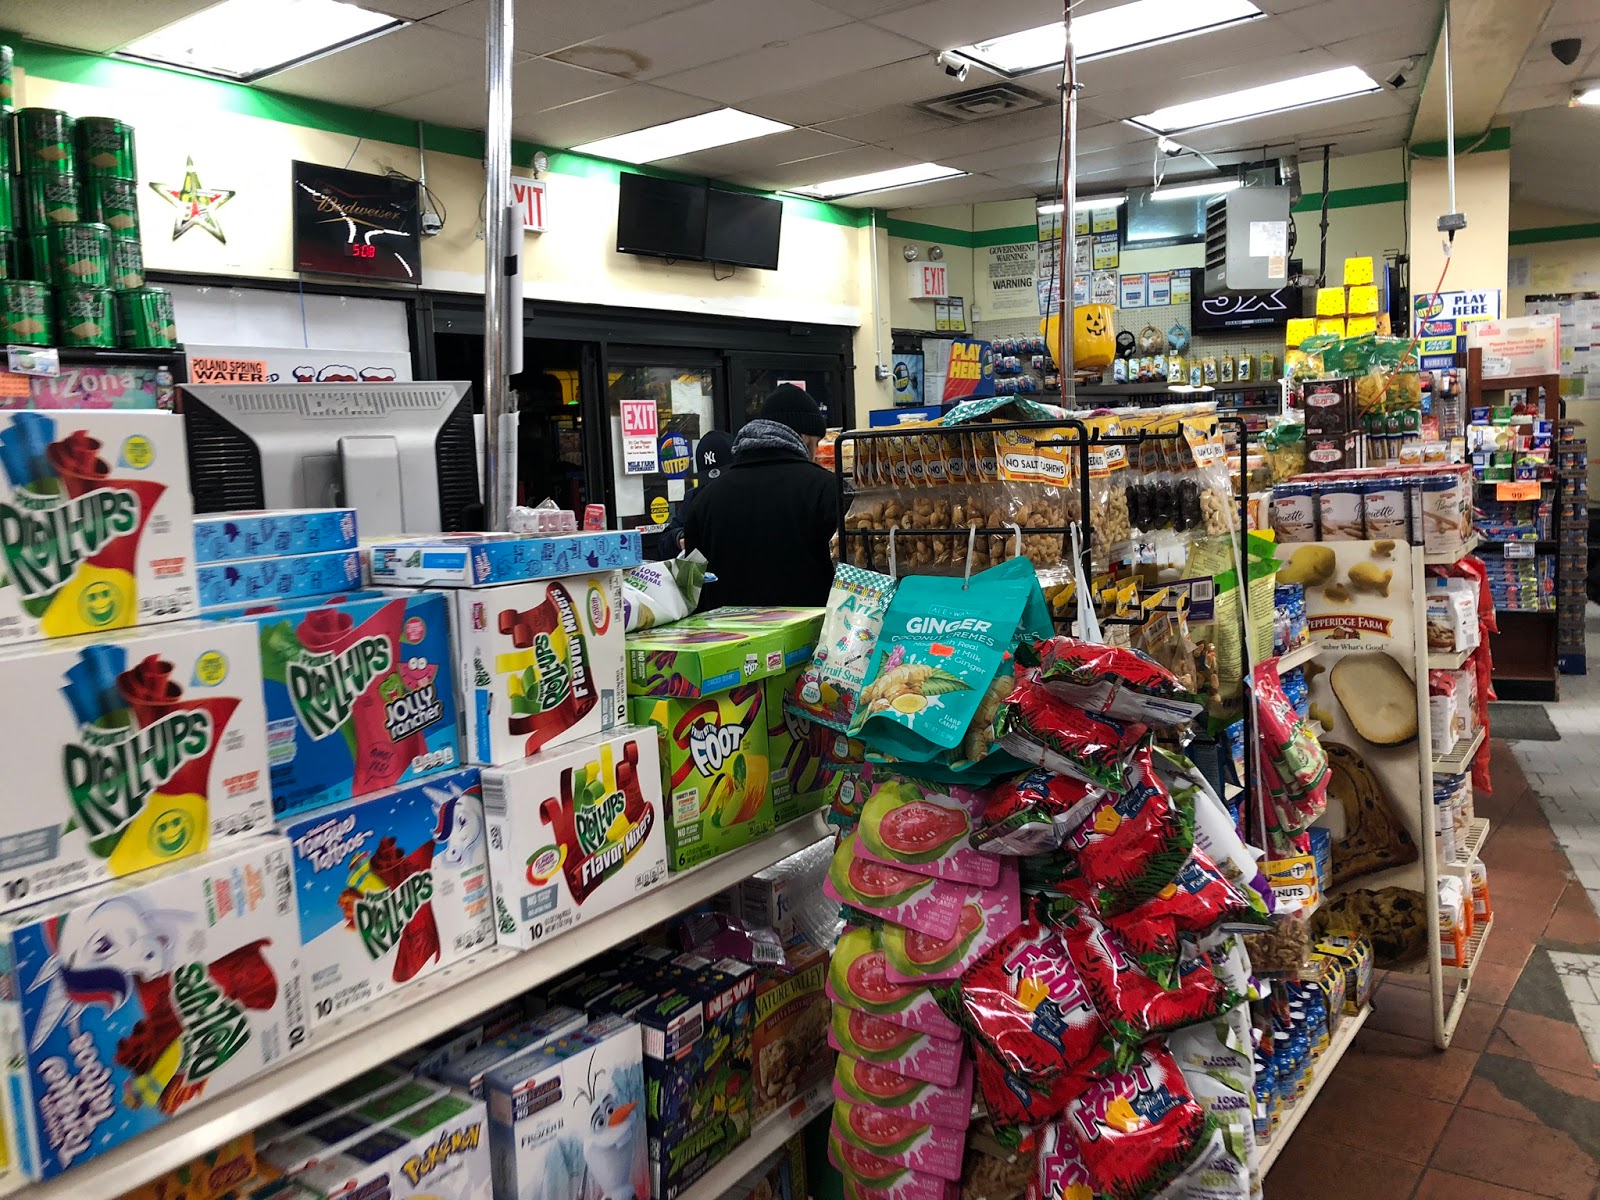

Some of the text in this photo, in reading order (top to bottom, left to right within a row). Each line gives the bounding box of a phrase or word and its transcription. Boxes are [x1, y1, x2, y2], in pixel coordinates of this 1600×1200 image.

[313, 195, 401, 220] Budweiser
[512, 183, 543, 227] XIT
[989, 244, 1037, 255] GOVERNMENT
[923, 266, 945, 296] EXIT
[992, 278, 1033, 290] WARNING
[1455, 294, 1487, 306] PLAY
[1452, 304, 1488, 316] HERE
[953, 341, 982, 362] PLAY
[193, 359, 262, 373] POLAND SPRING
[949, 361, 982, 380] HERE
[30, 370, 136, 398] riZona
[194, 370, 263, 382] WATER
[623, 404, 655, 431] EXIT
[1006, 458, 1019, 468] NO
[1021, 459, 1038, 469] SALT
[630, 570, 662, 587] BANANAS,
[640, 566, 662, 579] LOOK
[550, 589, 578, 634] Mixers
[837, 594, 882, 623] AriZ
[906, 616, 993, 634] GINGER
[1358, 617, 1383, 631] FARM
[891, 631, 995, 647] COCONUT CREMES
[957, 640, 979, 651] Real
[637, 650, 645, 662] NO
[962, 649, 982, 663] Milk
[568, 636, 588, 699] Flavor
[822, 663, 863, 686] Fruit Snac
[955, 656, 986, 675] Ginger
[386, 685, 434, 728] JOLLY
[617, 704, 626, 720] 10
[391, 703, 441, 738] rancher
[602, 713, 609, 726] NO
[690, 725, 745, 777] FOOT
[575, 791, 626, 854] ROLL-UPS
[774, 810, 780, 822] 6
[625, 811, 652, 855] Mixers
[678, 827, 686, 838] NO
[582, 842, 625, 887] Flavor
[679, 853, 686, 866] 6
[1274, 887, 1304, 899] LNUTS
[529, 923, 543, 941] 10
[709, 974, 755, 1019] NEW!
[755, 967, 822, 1019] NATURE VALLEY
[314, 999, 333, 1018] 10
[516, 1093, 528, 1105] NO
[1136, 1091, 1167, 1113] Spicy
[517, 1106, 529, 1120] NO
